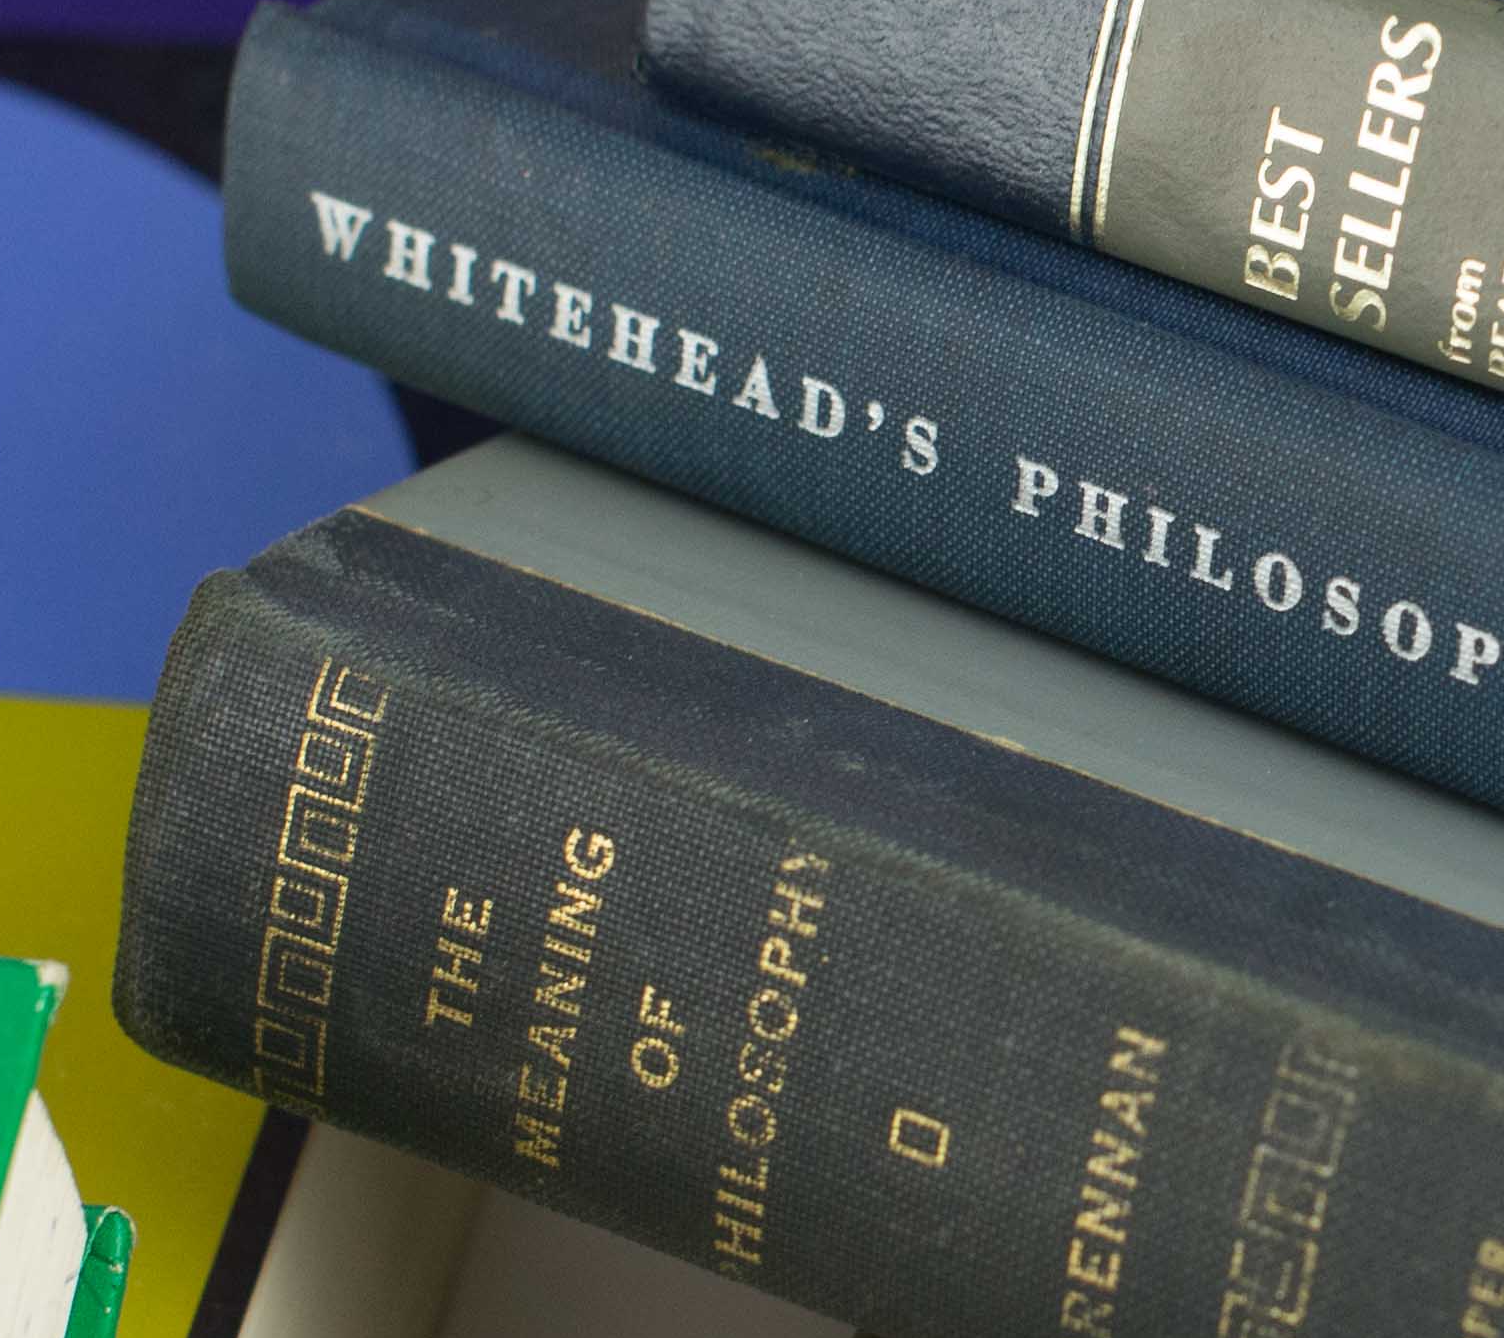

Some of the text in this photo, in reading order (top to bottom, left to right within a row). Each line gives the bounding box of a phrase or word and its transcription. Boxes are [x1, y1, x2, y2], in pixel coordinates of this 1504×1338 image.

[1243, 105, 1325, 302] BEST
[1330, 15, 1444, 333] SELLERS
[309, 191, 942, 476] WHITEHEAD'S
[1437, 257, 1487, 365] from
[422, 886, 494, 1029] THE
[513, 826, 617, 1169] MEANING
[630, 983, 687, 1090] OF
[713, 849, 832, 1269] HILOSOPHY
